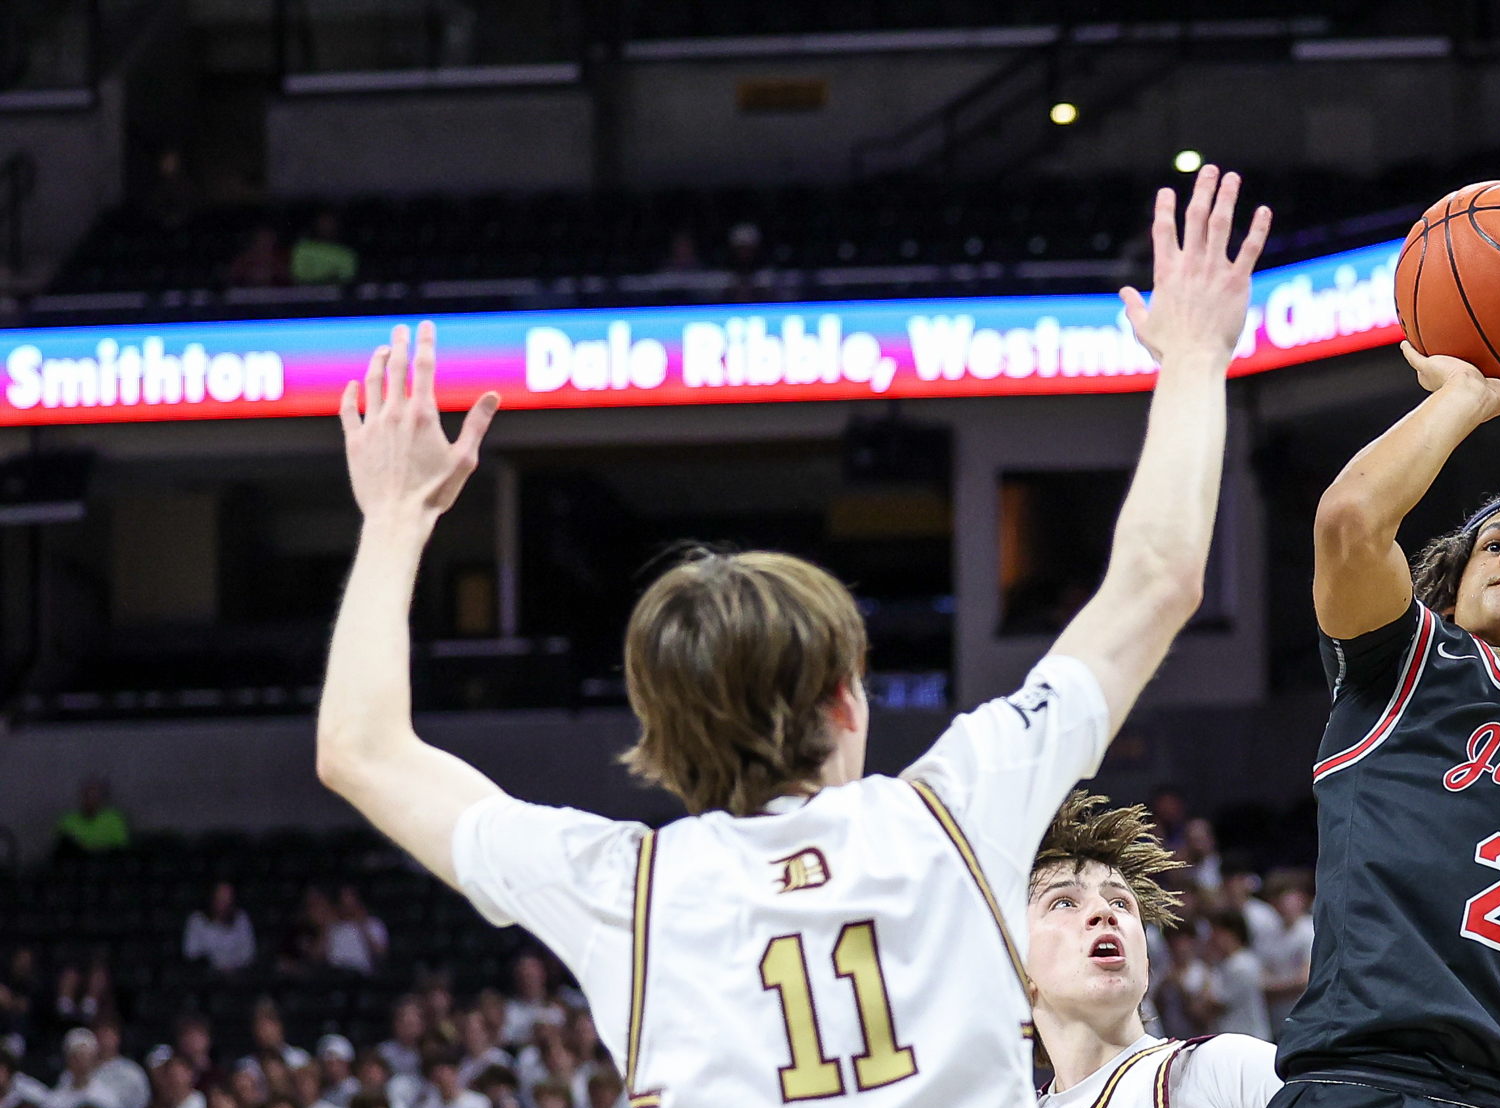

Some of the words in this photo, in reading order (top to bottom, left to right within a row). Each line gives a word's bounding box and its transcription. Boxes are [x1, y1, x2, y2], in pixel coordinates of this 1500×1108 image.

[6, 337, 284, 408] Smithton
[526, 320, 668, 392] Dale
[682, 313, 897, 393] Ribble,
[769, 846, 832, 894] D
[758, 918, 920, 1104] 11
